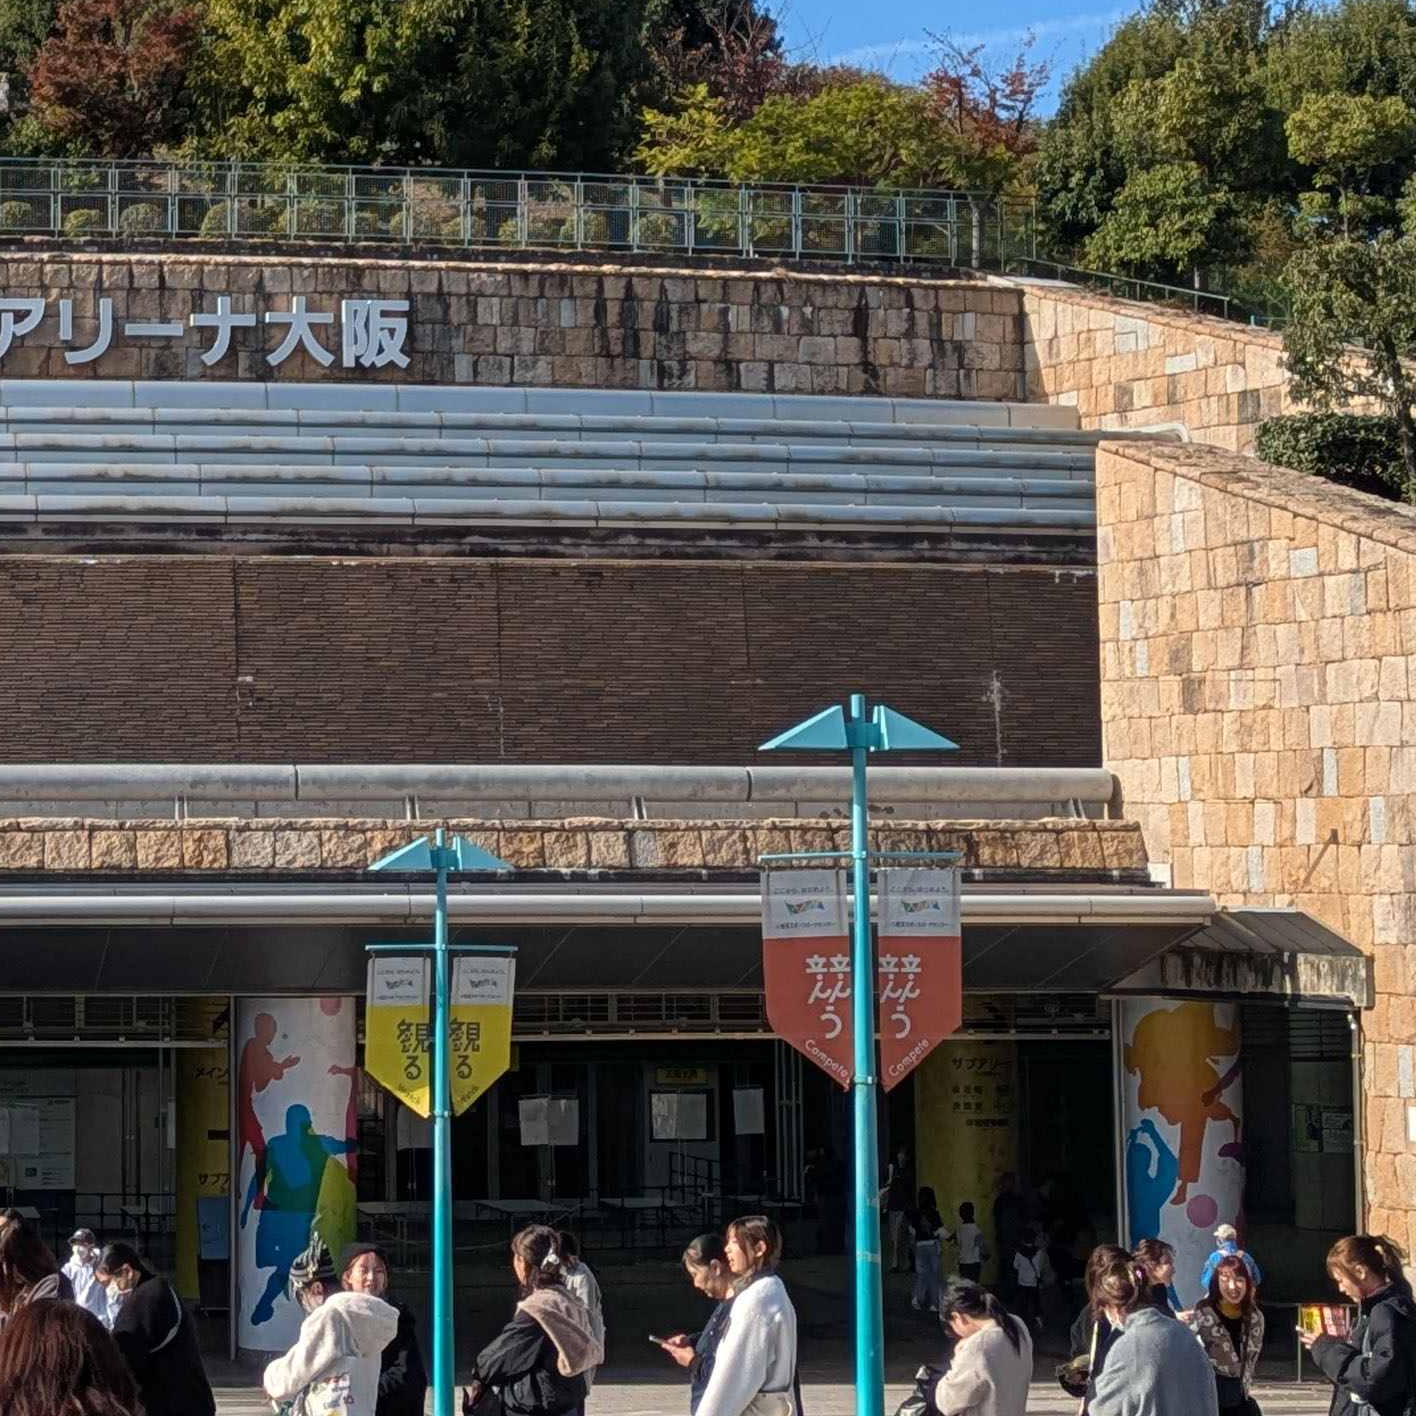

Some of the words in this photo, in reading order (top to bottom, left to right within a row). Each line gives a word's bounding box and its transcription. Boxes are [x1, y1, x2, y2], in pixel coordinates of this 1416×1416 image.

[397, 1017, 430, 1081] 観る
[449, 1017, 481, 1080] 観る
[805, 1038, 849, 1077] Compete
[888, 1037, 930, 1077] Compete
